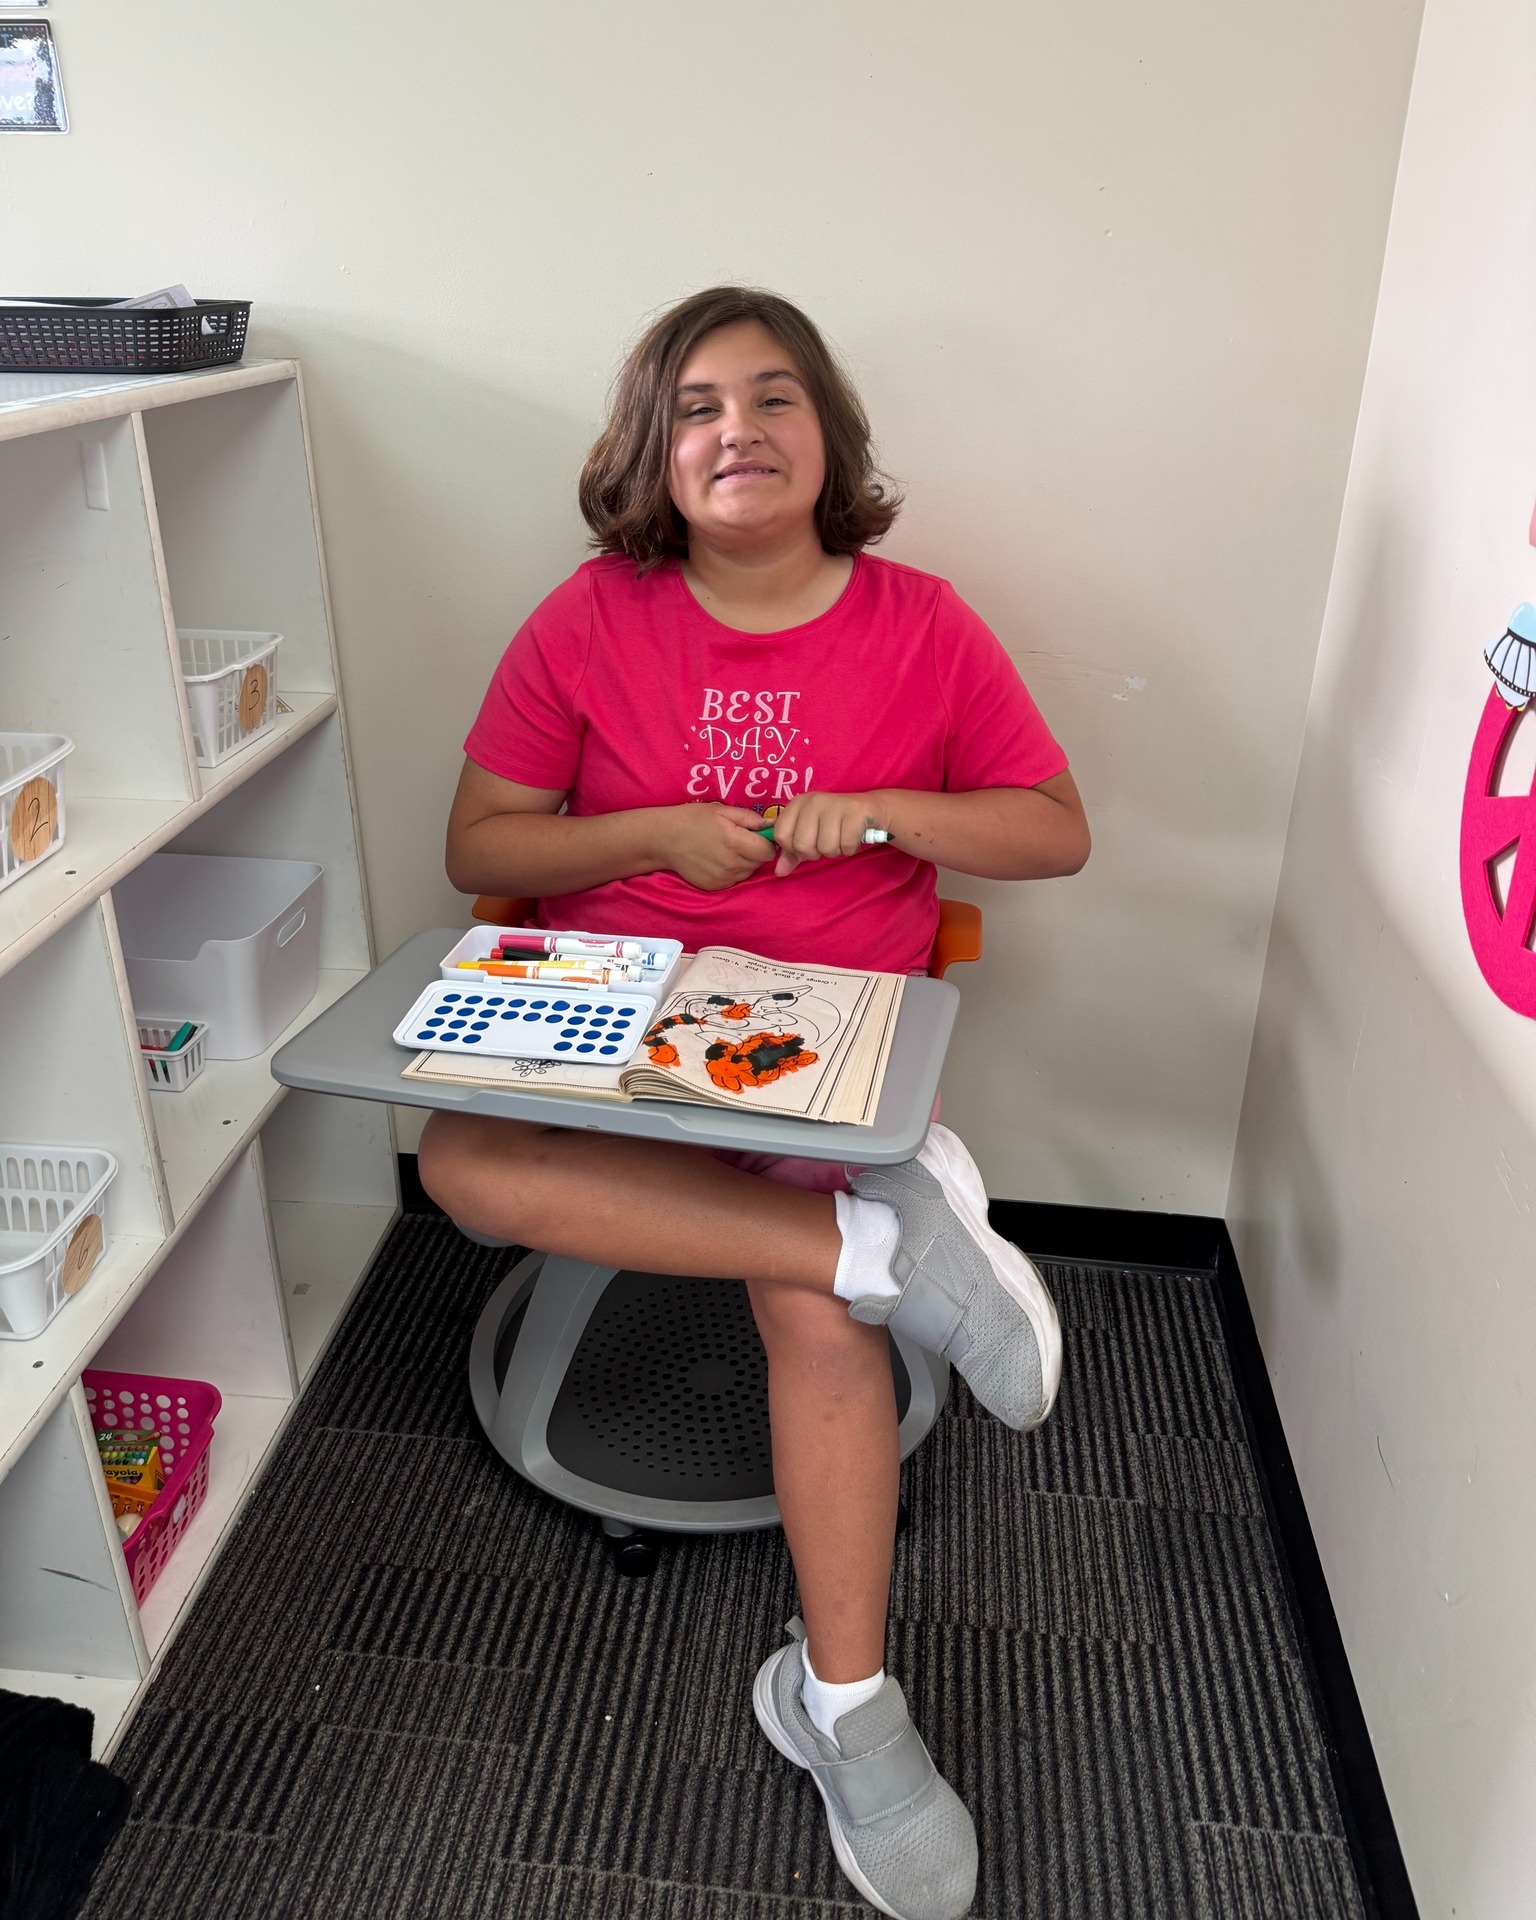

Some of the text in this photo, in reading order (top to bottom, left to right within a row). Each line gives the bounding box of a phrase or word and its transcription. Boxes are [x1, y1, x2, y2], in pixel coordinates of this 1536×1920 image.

[248, 678, 260, 711] 3
[699, 688, 800, 724] BEST
[699, 724, 801, 764] DAY
[687, 764, 813, 800] EVER!
[27, 797, 49, 842] 2
[78, 1233, 88, 1270] 6
[98, 1432, 113, 1441] 24
